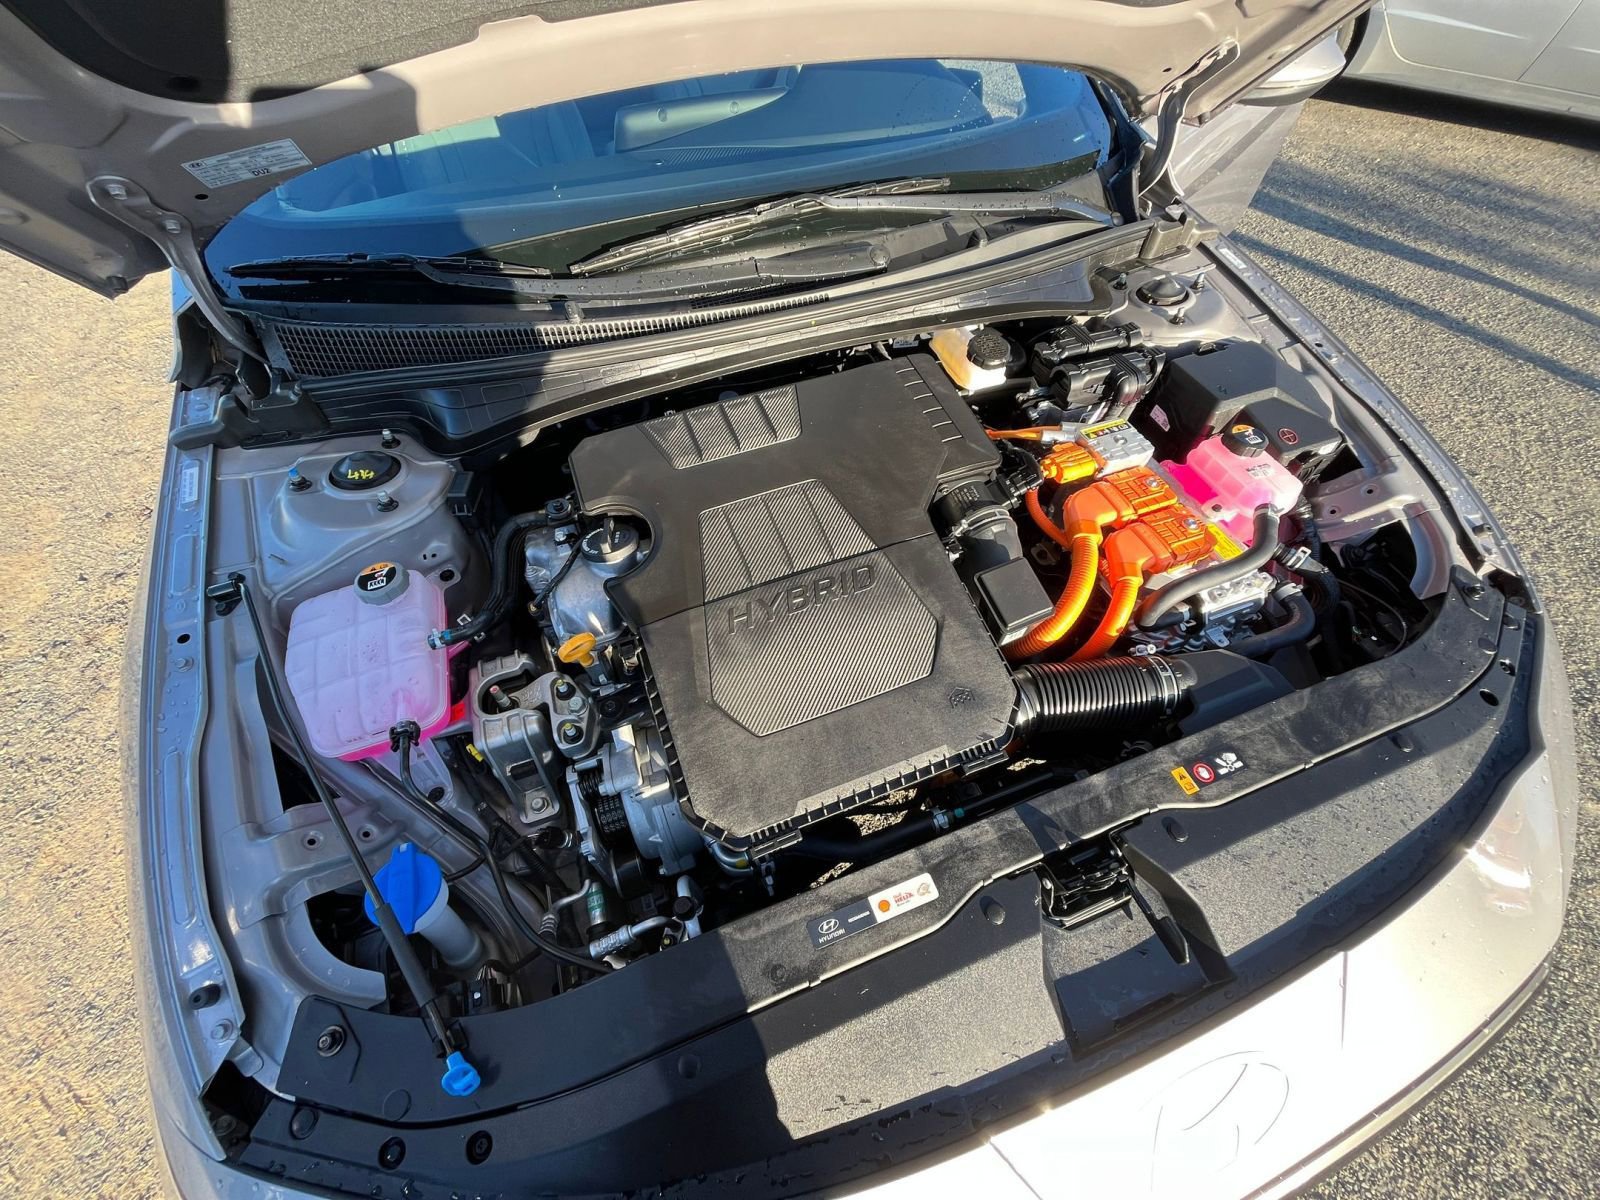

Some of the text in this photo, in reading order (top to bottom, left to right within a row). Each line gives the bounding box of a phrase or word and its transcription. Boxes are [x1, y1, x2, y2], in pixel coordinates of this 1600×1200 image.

[252, 167, 270, 177] DU2
[728, 565, 876, 635] HYBRID
[819, 928, 846, 944] HYUNDAI
